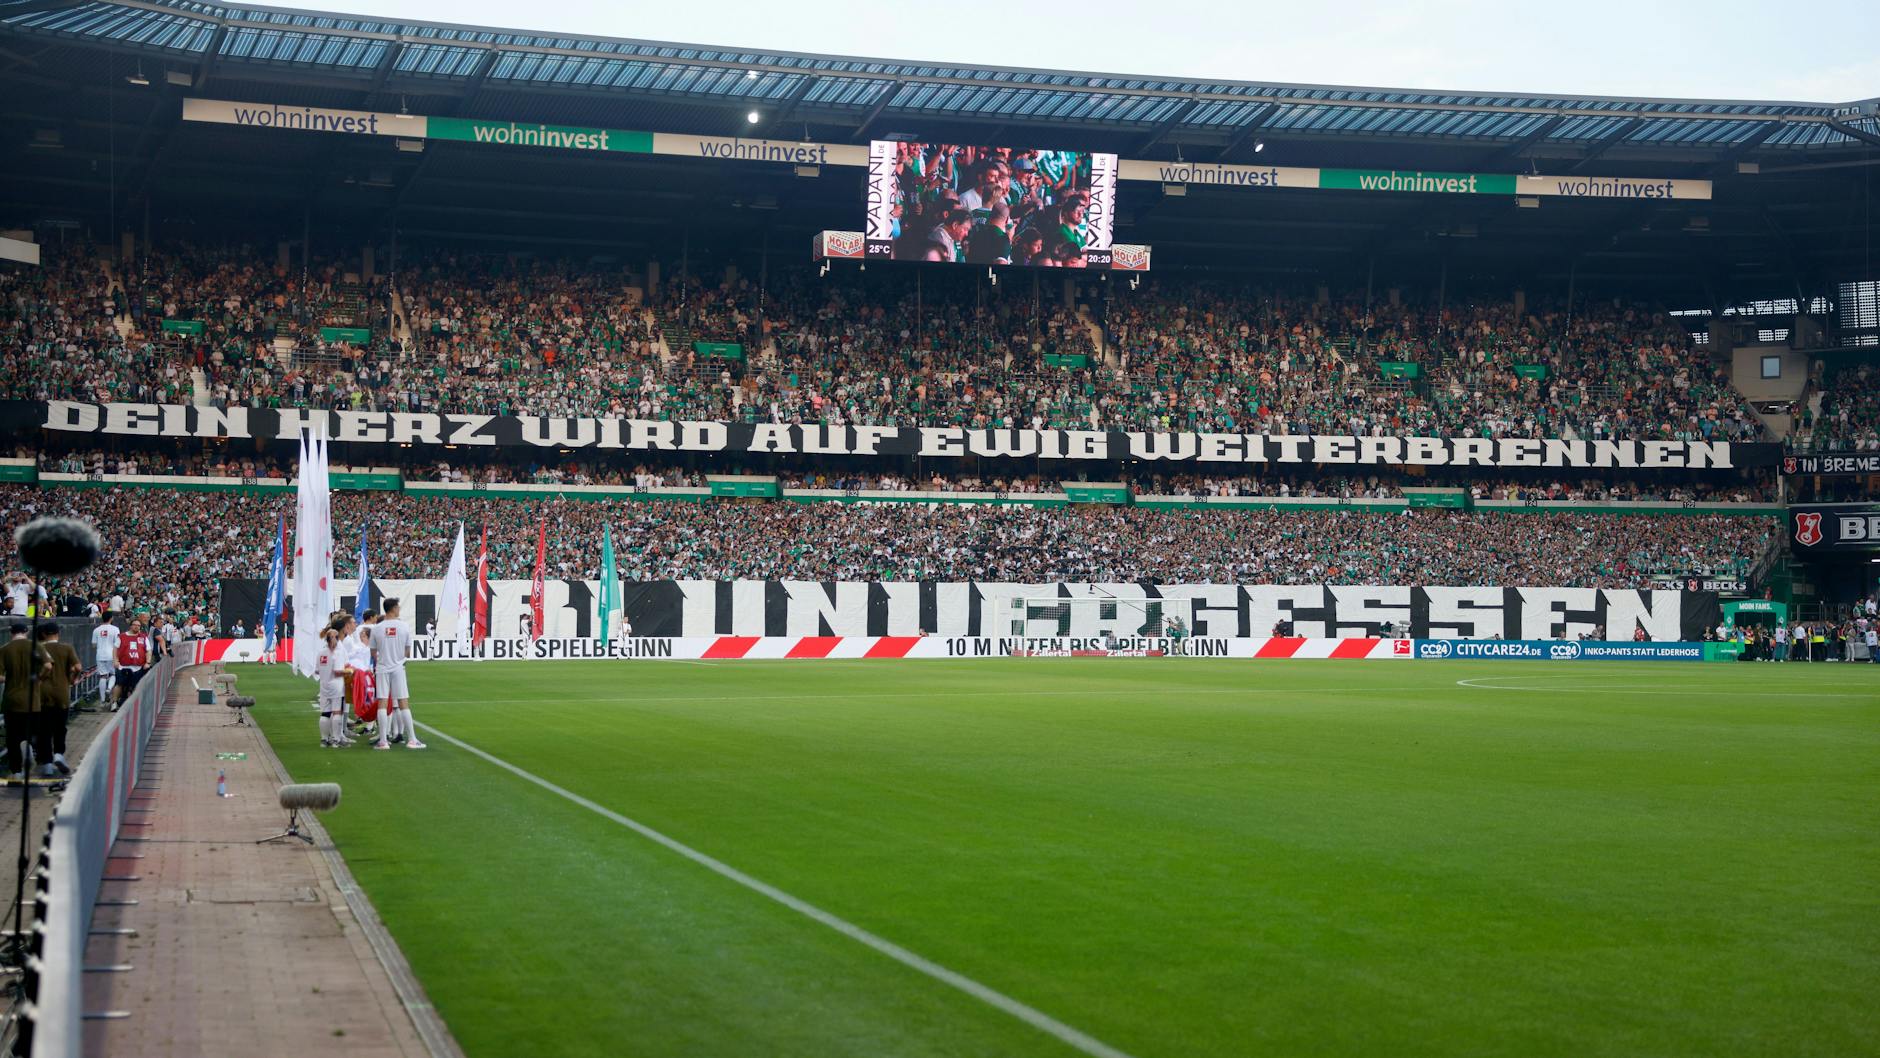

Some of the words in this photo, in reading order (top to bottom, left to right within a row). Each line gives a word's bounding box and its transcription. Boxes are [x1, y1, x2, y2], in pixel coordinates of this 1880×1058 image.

[234, 104, 379, 134] wohninvest
[473, 122, 609, 150] wohninvest
[700, 137, 828, 163] wohninvest
[1160, 162, 1279, 186] wohninvest
[1359, 171, 1477, 193] wohninvest
[867, 157, 884, 238] VADANI
[1558, 177, 1674, 198] wohninvest
[1087, 168, 1105, 248] VADANI
[869, 245, 890, 254] 25°C
[1088, 254, 1111, 263] 20:20
[41, 400, 249, 437] DEIN
[275, 408, 496, 446] HERZ
[516, 415, 728, 451] WIRD
[746, 423, 899, 455] AUF
[918, 427, 1108, 460] EWIG
[1125, 432, 1734, 469] WEITERBRENNEN
[1799, 457, 1818, 472] IN
[946, 638, 966, 656] 10
[1420, 643, 1448, 655] CC24
[1456, 643, 1542, 656] CITYCARE24.DE
[1550, 645, 1578, 656] CC24
[1584, 647, 1631, 656] INKO-PANTS
[1633, 648, 1655, 656] STATT
[1657, 648, 1700, 656] LEDERHOSE
